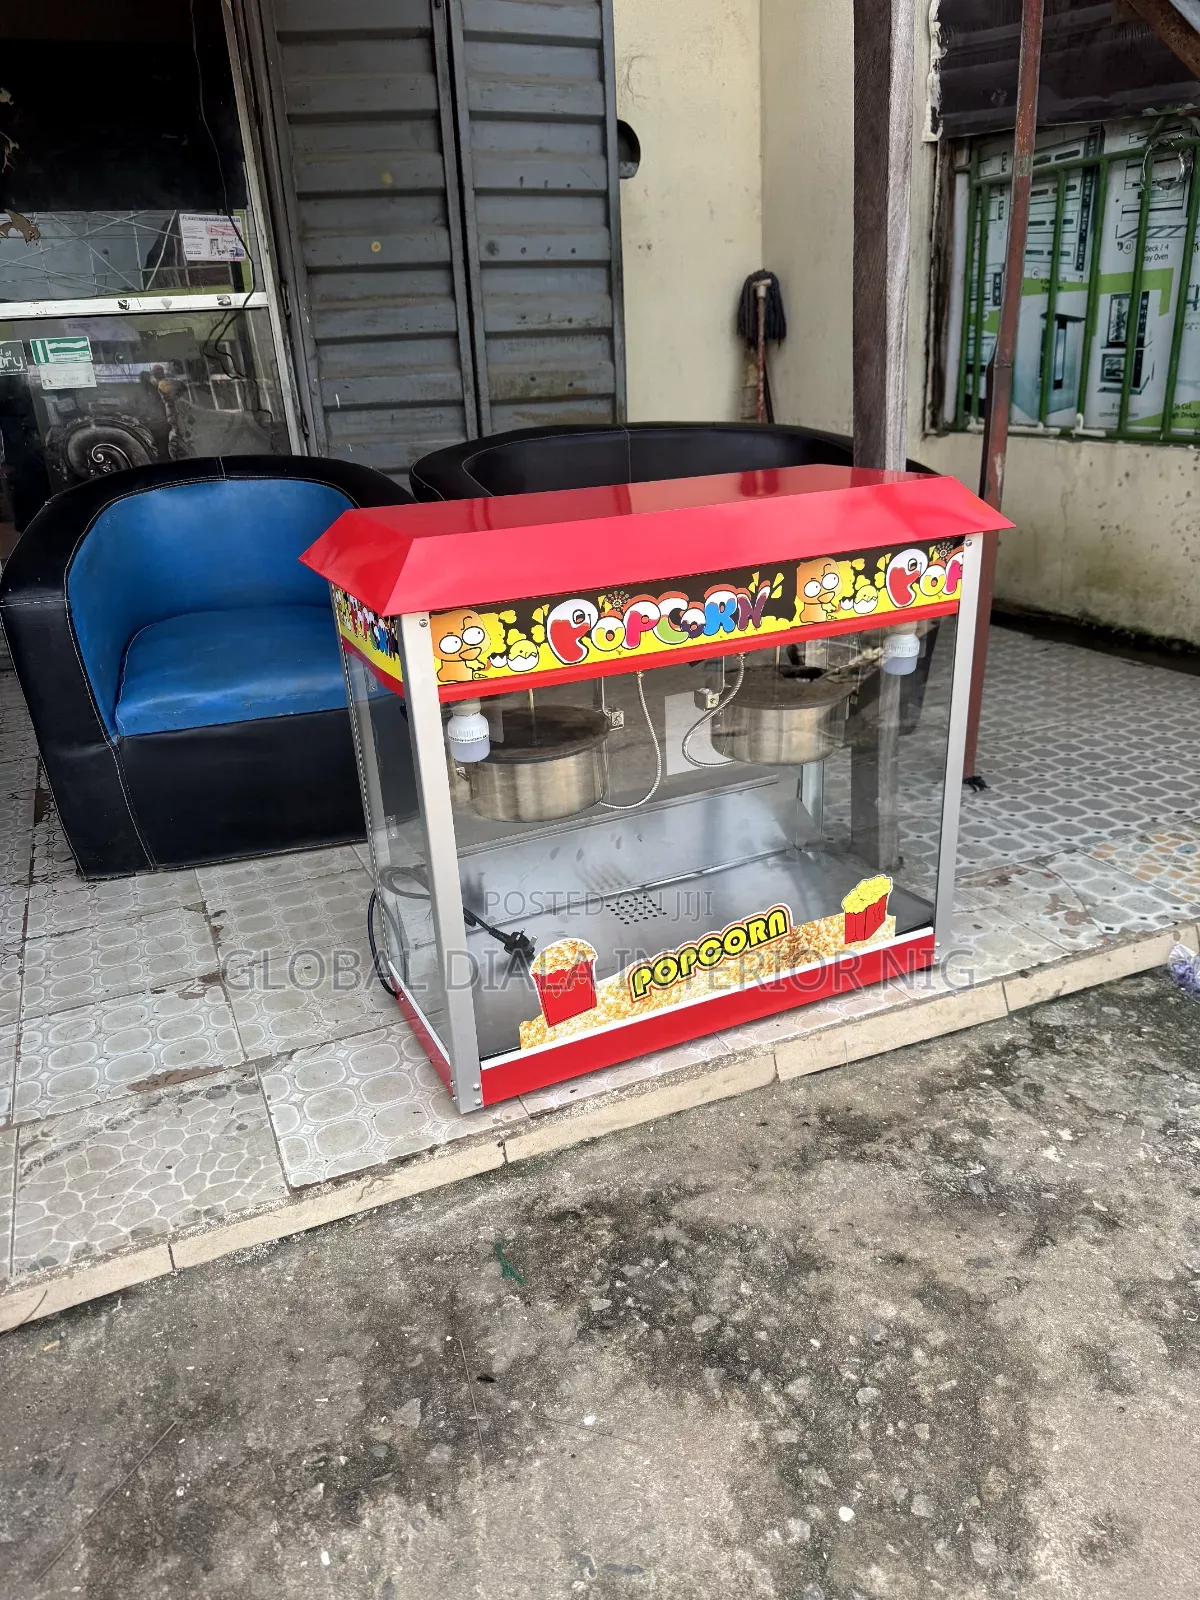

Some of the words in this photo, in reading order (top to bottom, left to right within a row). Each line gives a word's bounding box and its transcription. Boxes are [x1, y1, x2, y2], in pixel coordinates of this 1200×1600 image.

[1153, 253, 1169, 261] Oven
[547, 580, 771, 665] POPCORN
[631, 910, 791, 999] POPCORN
